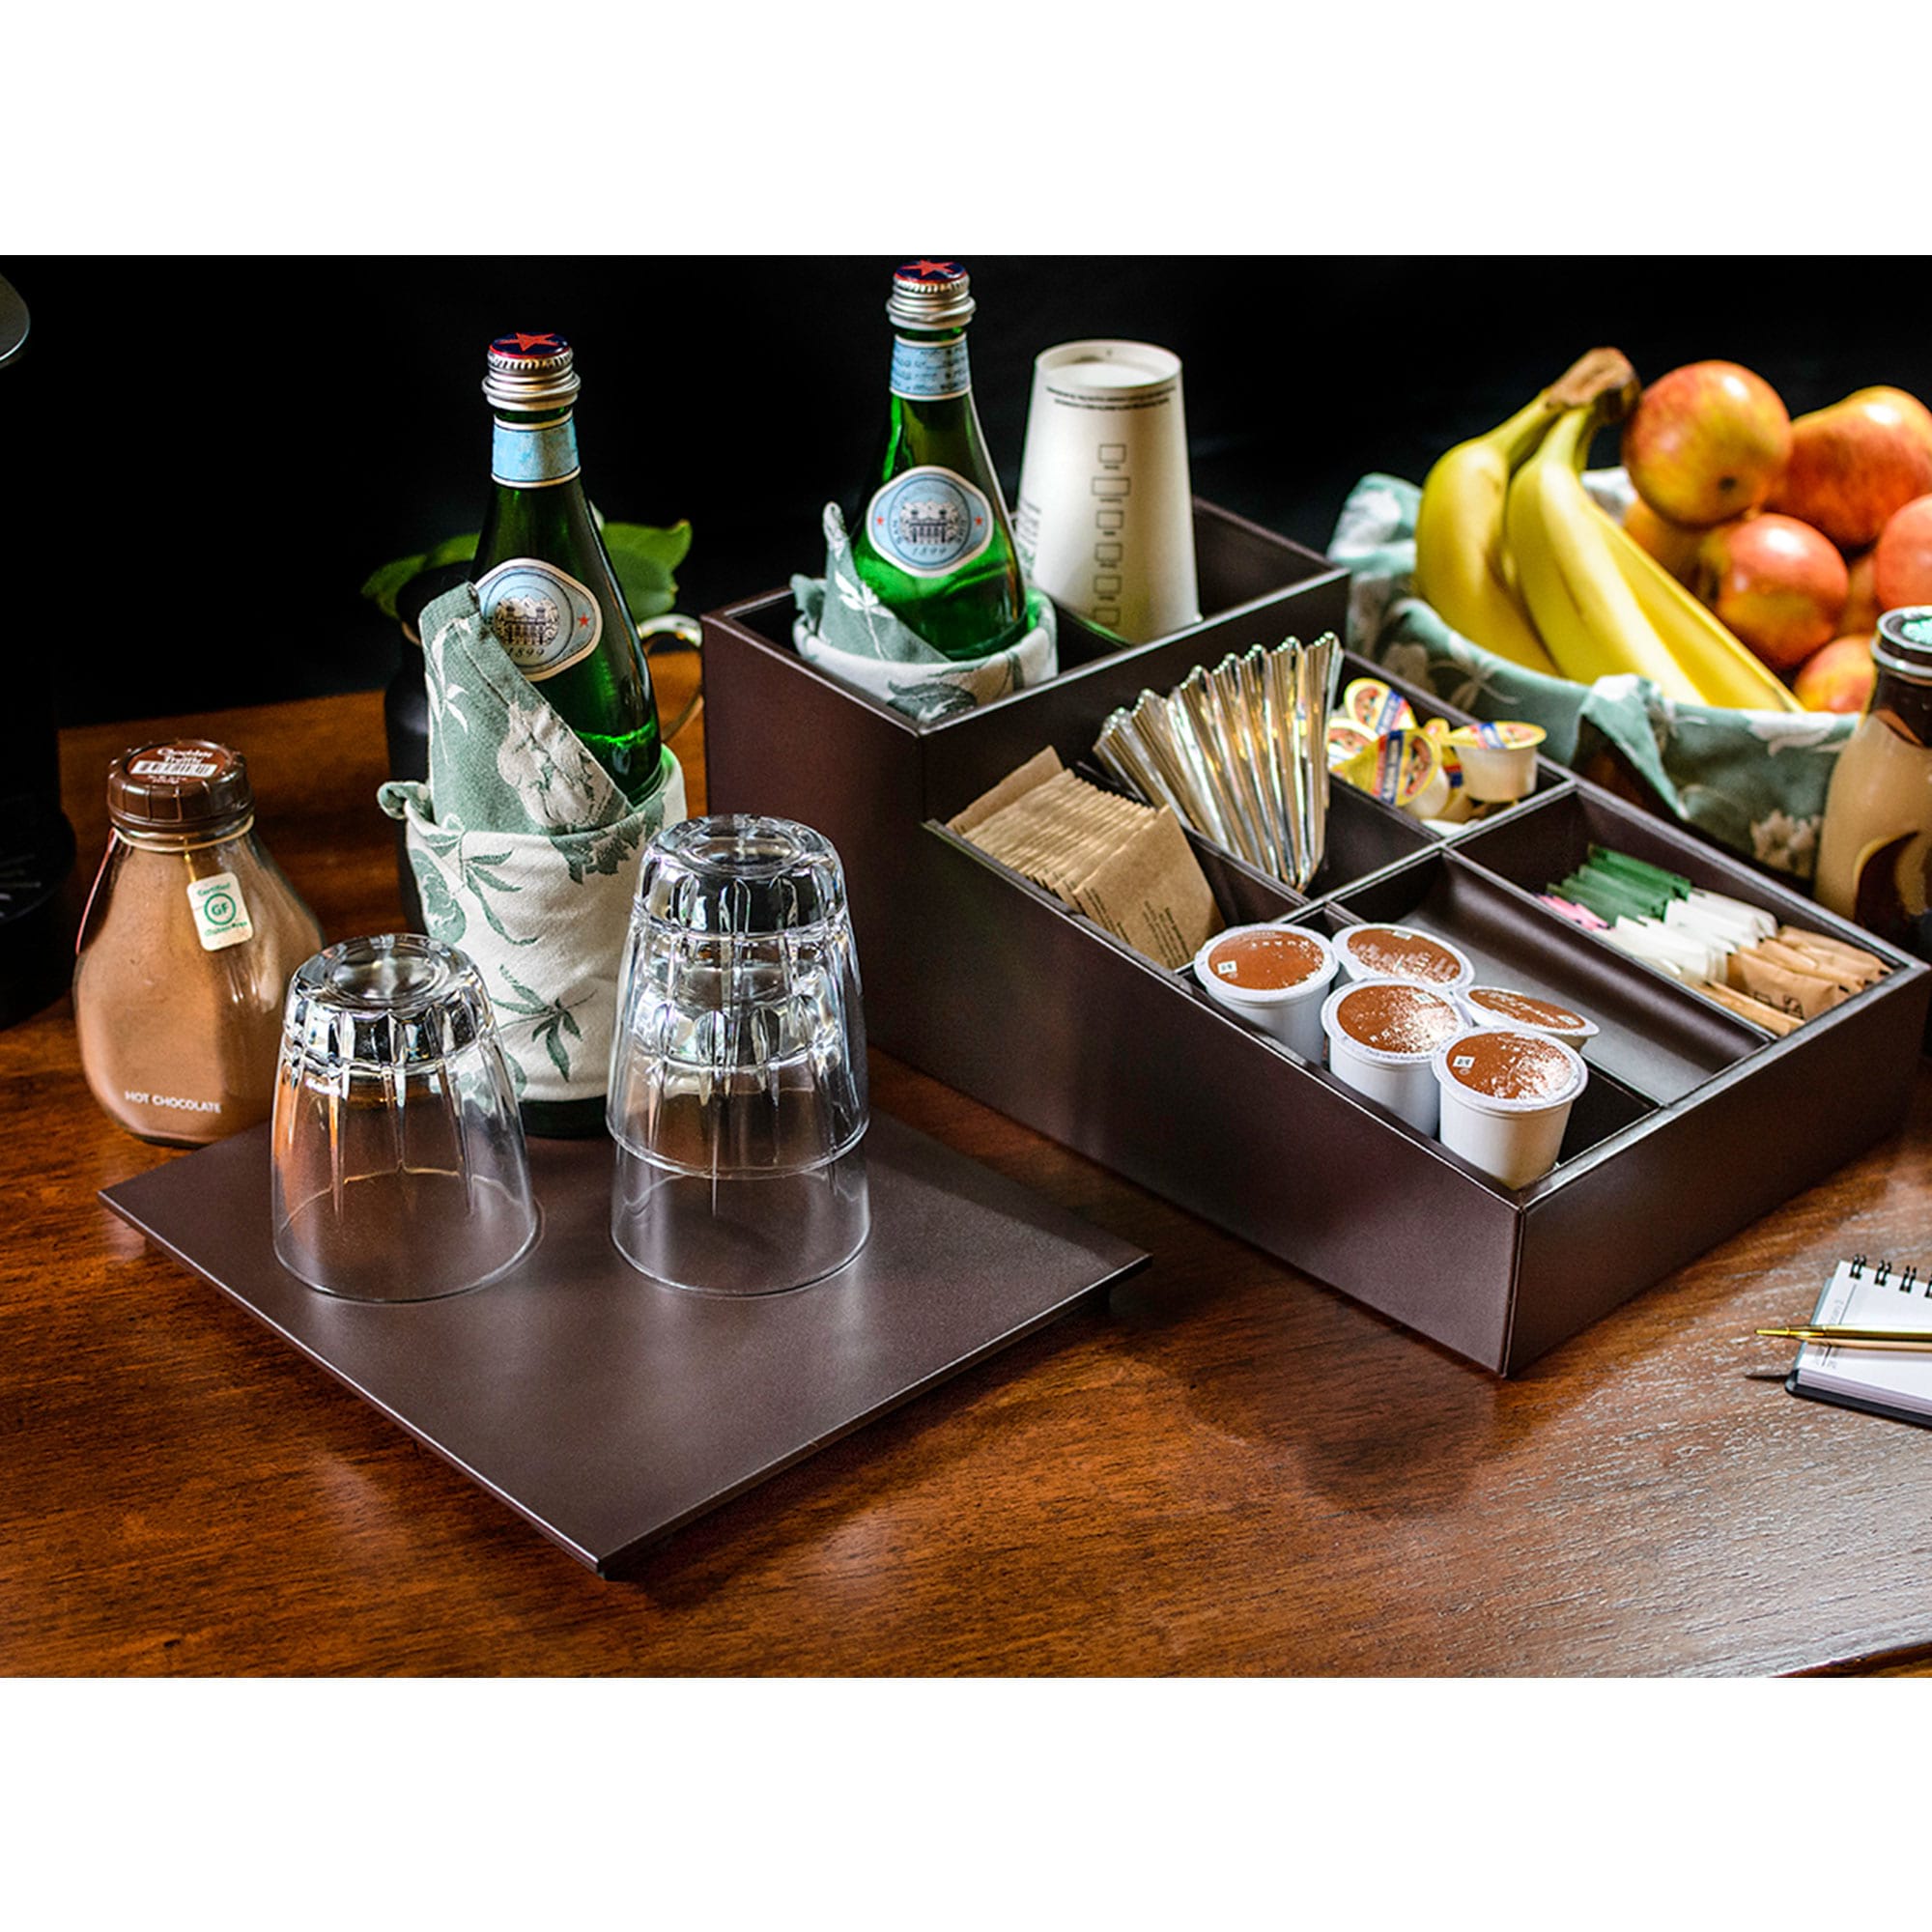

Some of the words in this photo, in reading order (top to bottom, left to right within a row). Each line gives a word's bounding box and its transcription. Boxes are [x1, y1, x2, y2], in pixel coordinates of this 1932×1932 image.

[211, 901, 229, 917] GF
[125, 1091, 150, 1103] HOT
[152, 1094, 221, 1113] CHOCOLATE
